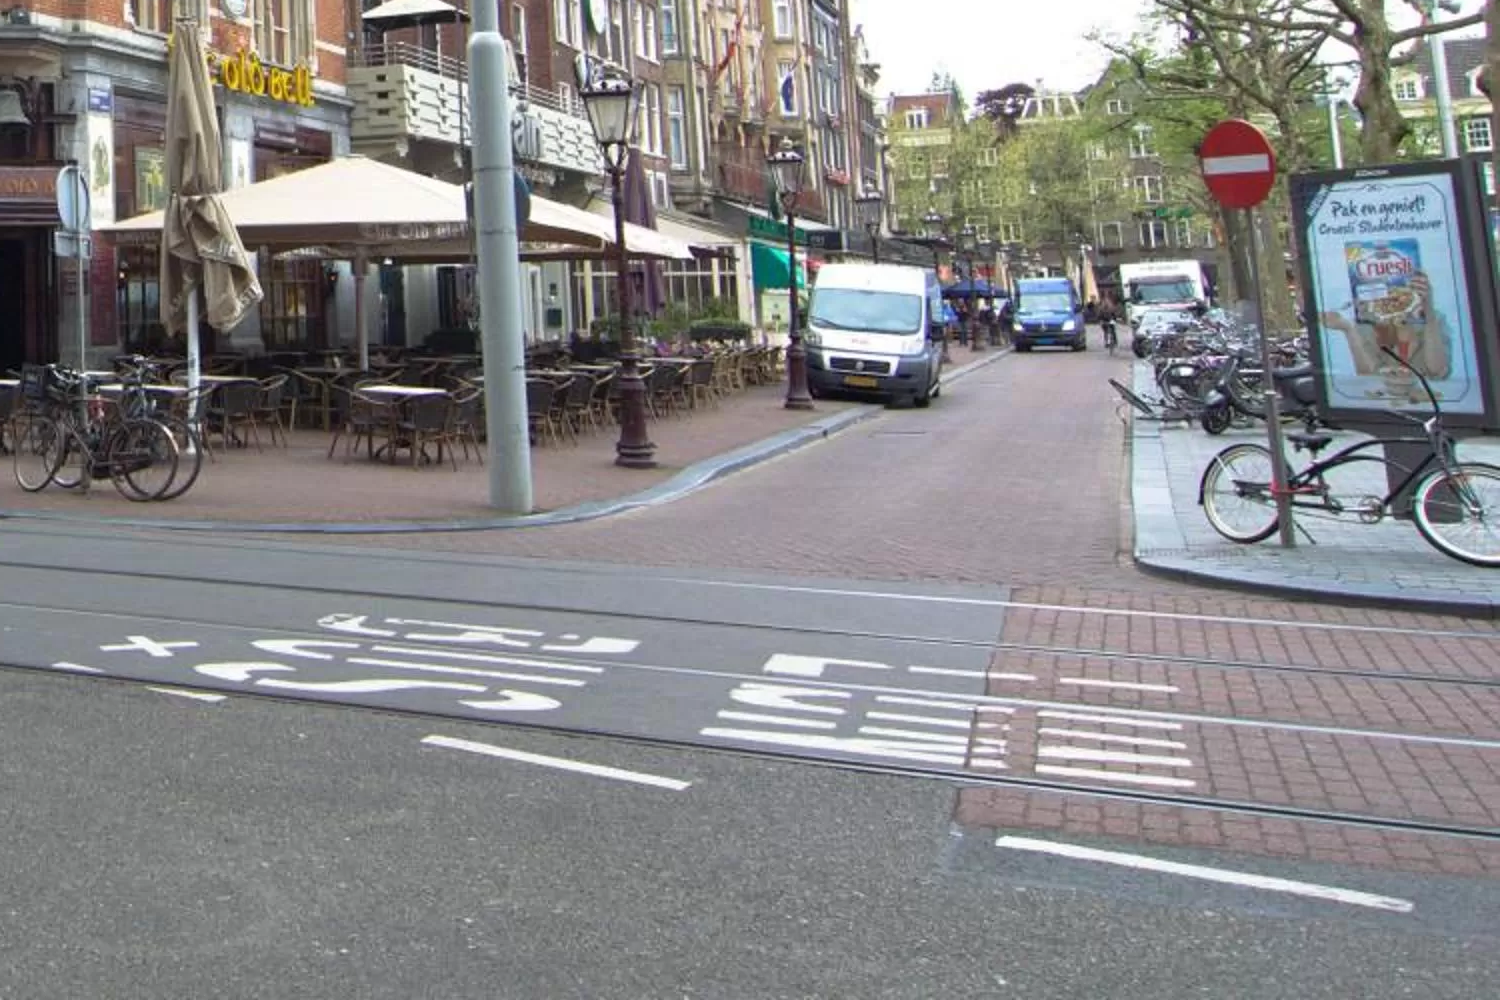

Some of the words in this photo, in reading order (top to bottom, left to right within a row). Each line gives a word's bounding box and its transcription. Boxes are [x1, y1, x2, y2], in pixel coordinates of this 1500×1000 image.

[1331, 199, 1358, 218] Pak
[1360, 203, 1376, 214] en
[1379, 194, 1426, 219] geniet!
